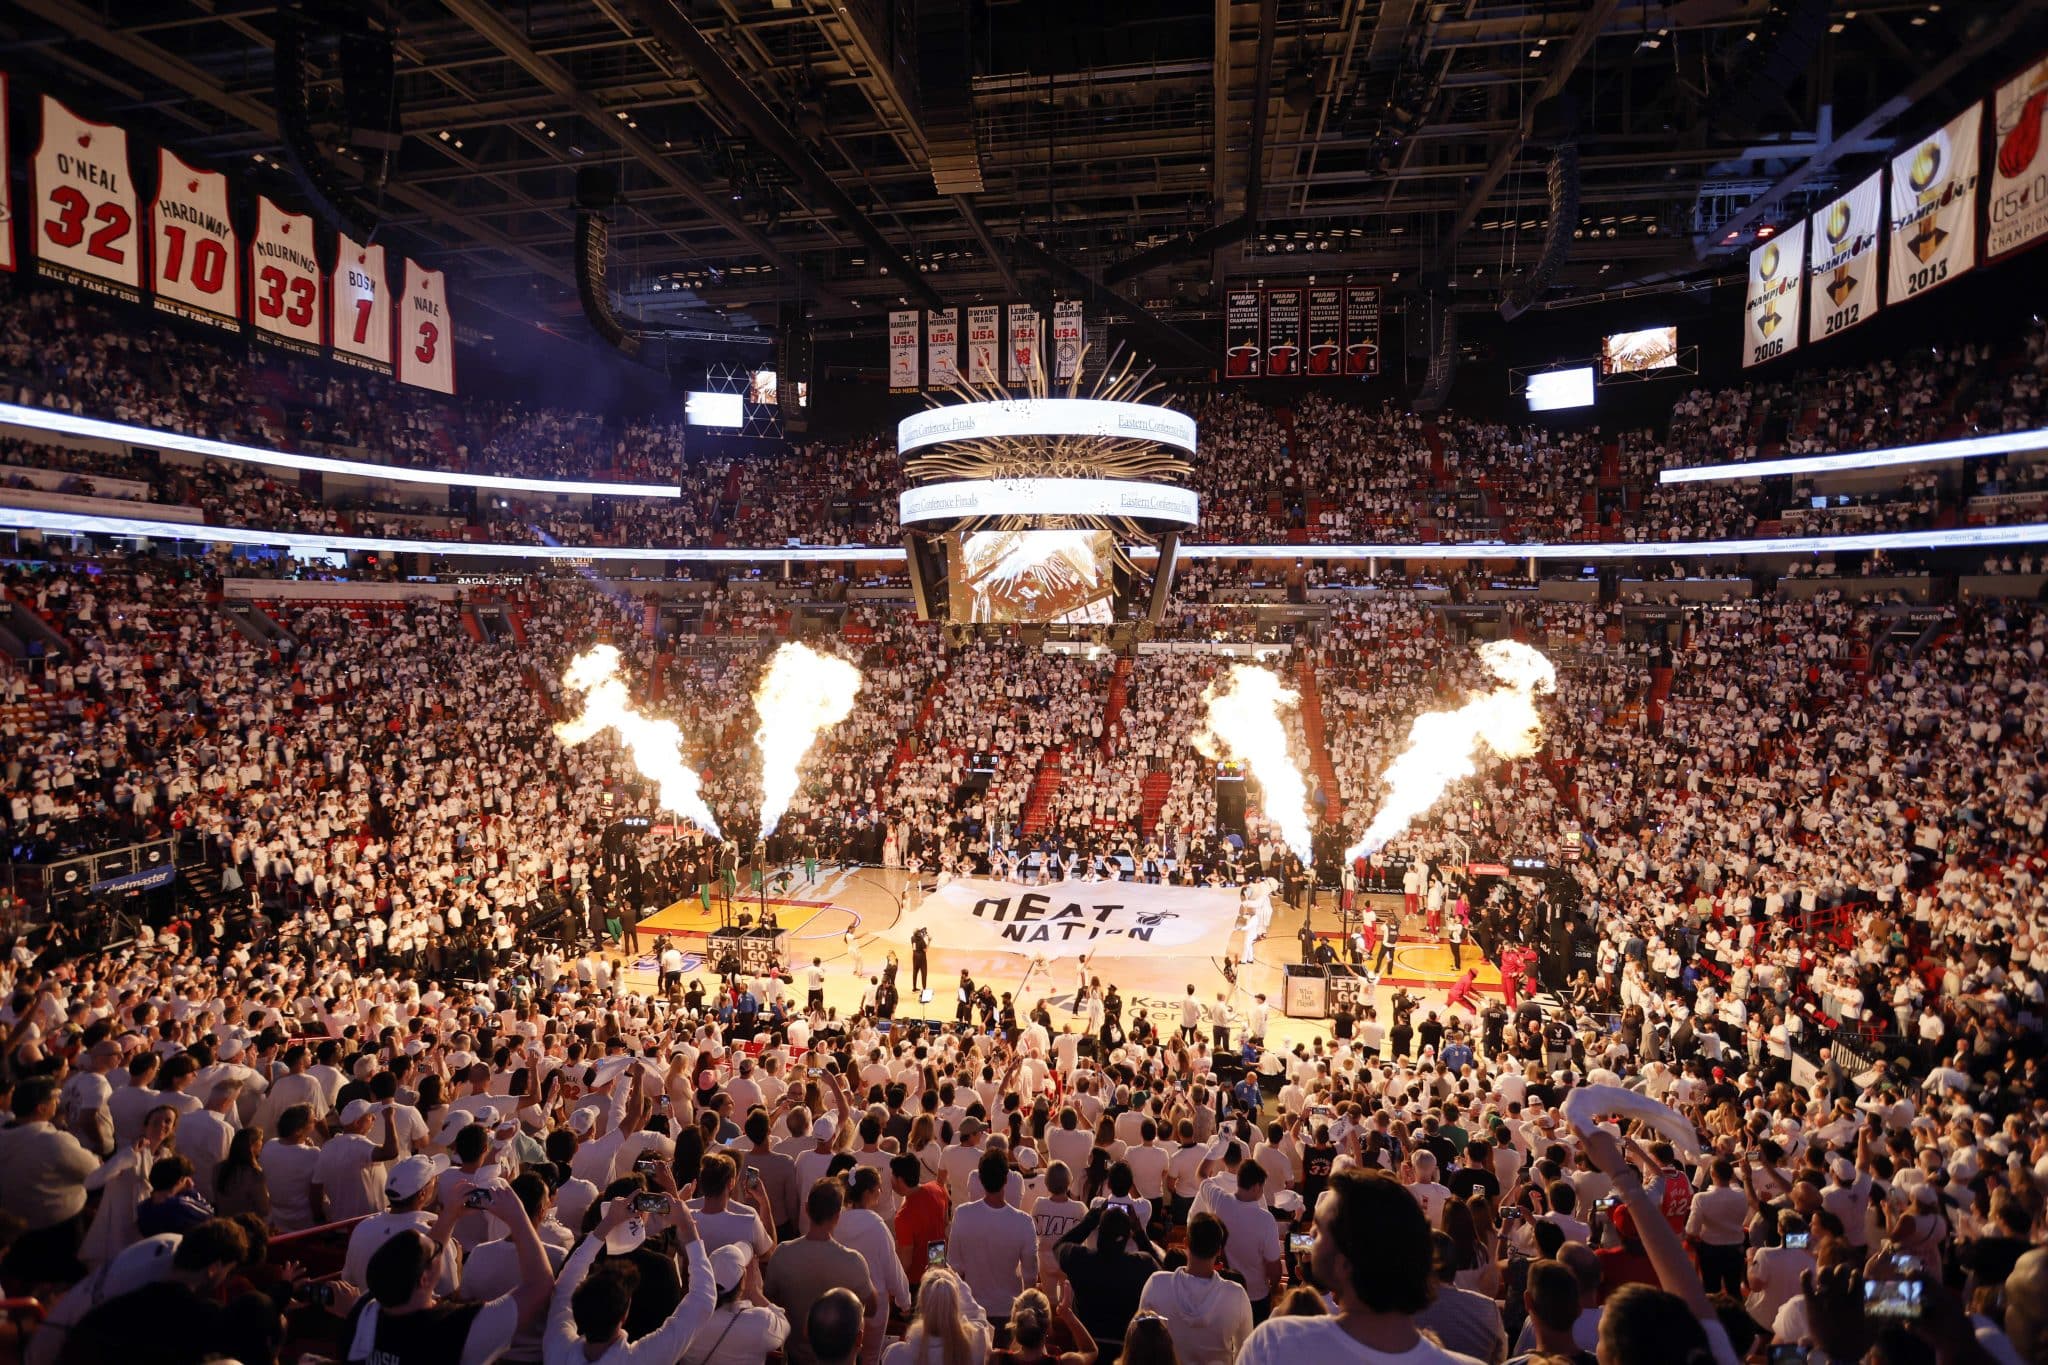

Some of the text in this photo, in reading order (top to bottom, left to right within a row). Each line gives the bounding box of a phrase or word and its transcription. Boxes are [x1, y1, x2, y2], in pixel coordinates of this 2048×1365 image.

[57, 153, 118, 194] O'NEAL
[44, 185, 132, 265] 32
[159, 200, 231, 240] HARDAWAY
[163, 225, 228, 294] 10
[256, 241, 316, 274] MOURNING
[38, 266, 65, 282] HALL
[68, 275, 80, 286] OF
[83, 278, 109, 296] FAME
[1907, 258, 1948, 295] 2013
[258, 265, 316, 328] 33
[413, 295, 440, 317] WADE
[154, 301, 177, 314] HALL
[178, 308, 189, 318] OF
[190, 311, 214, 325] FAME
[353, 299, 373, 344] 1
[1824, 304, 1860, 335] 2012
[415, 321, 439, 364] 3
[893, 335, 915, 344] USA
[931, 332, 954, 343] USA
[971, 330, 995, 340] USA
[1054, 328, 1079, 338] USA
[1754, 337, 1784, 363] 2006
[952, 416, 976, 430] Finals
[1119, 414, 1147, 429] Eastern
[955, 492, 978, 507] Finals
[1121, 493, 1149, 508] Eastern
[741, 939, 773, 951] LET'S
[747, 950, 768, 961] GO
[742, 961, 770, 974] HEA
[1337, 991, 1359, 1003] GO
[1309, 1165, 1331, 1176] 33
